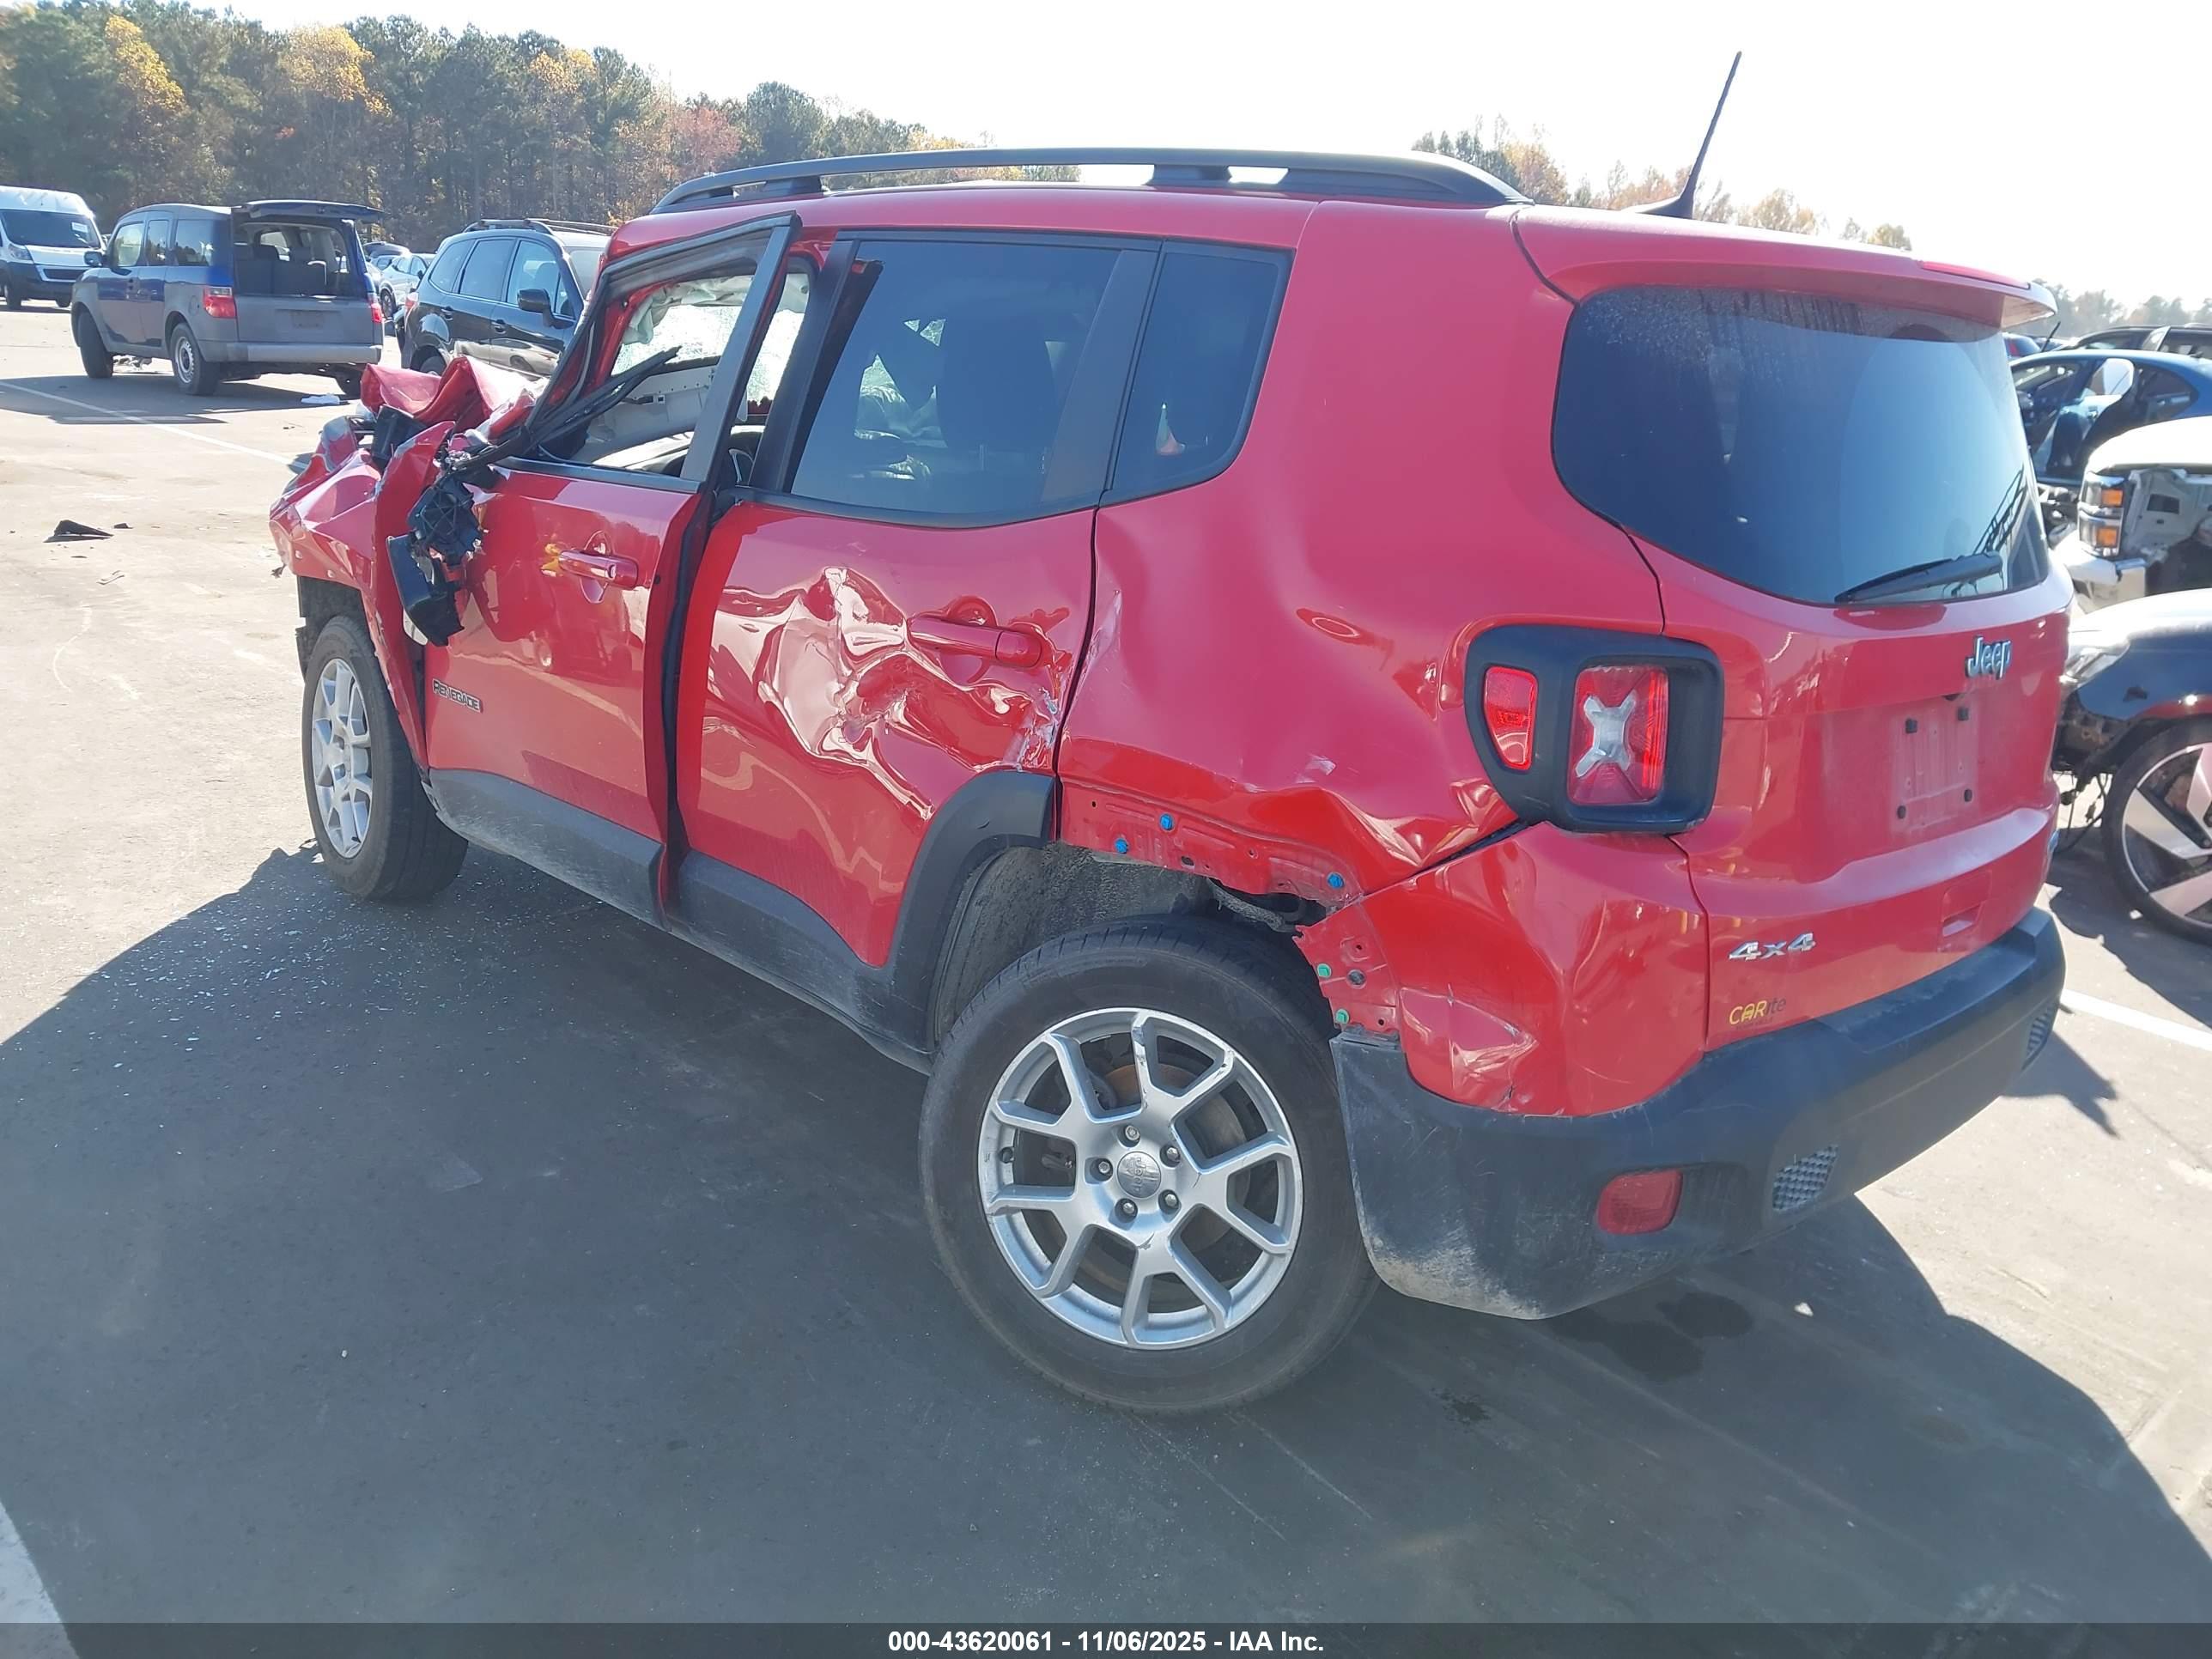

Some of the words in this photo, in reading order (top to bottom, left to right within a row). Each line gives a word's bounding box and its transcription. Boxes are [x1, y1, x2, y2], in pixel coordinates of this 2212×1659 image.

[1966, 635, 2011, 679] Jeep
[432, 678, 482, 713] RENEGADE
[1729, 932, 1816, 961] 4x4
